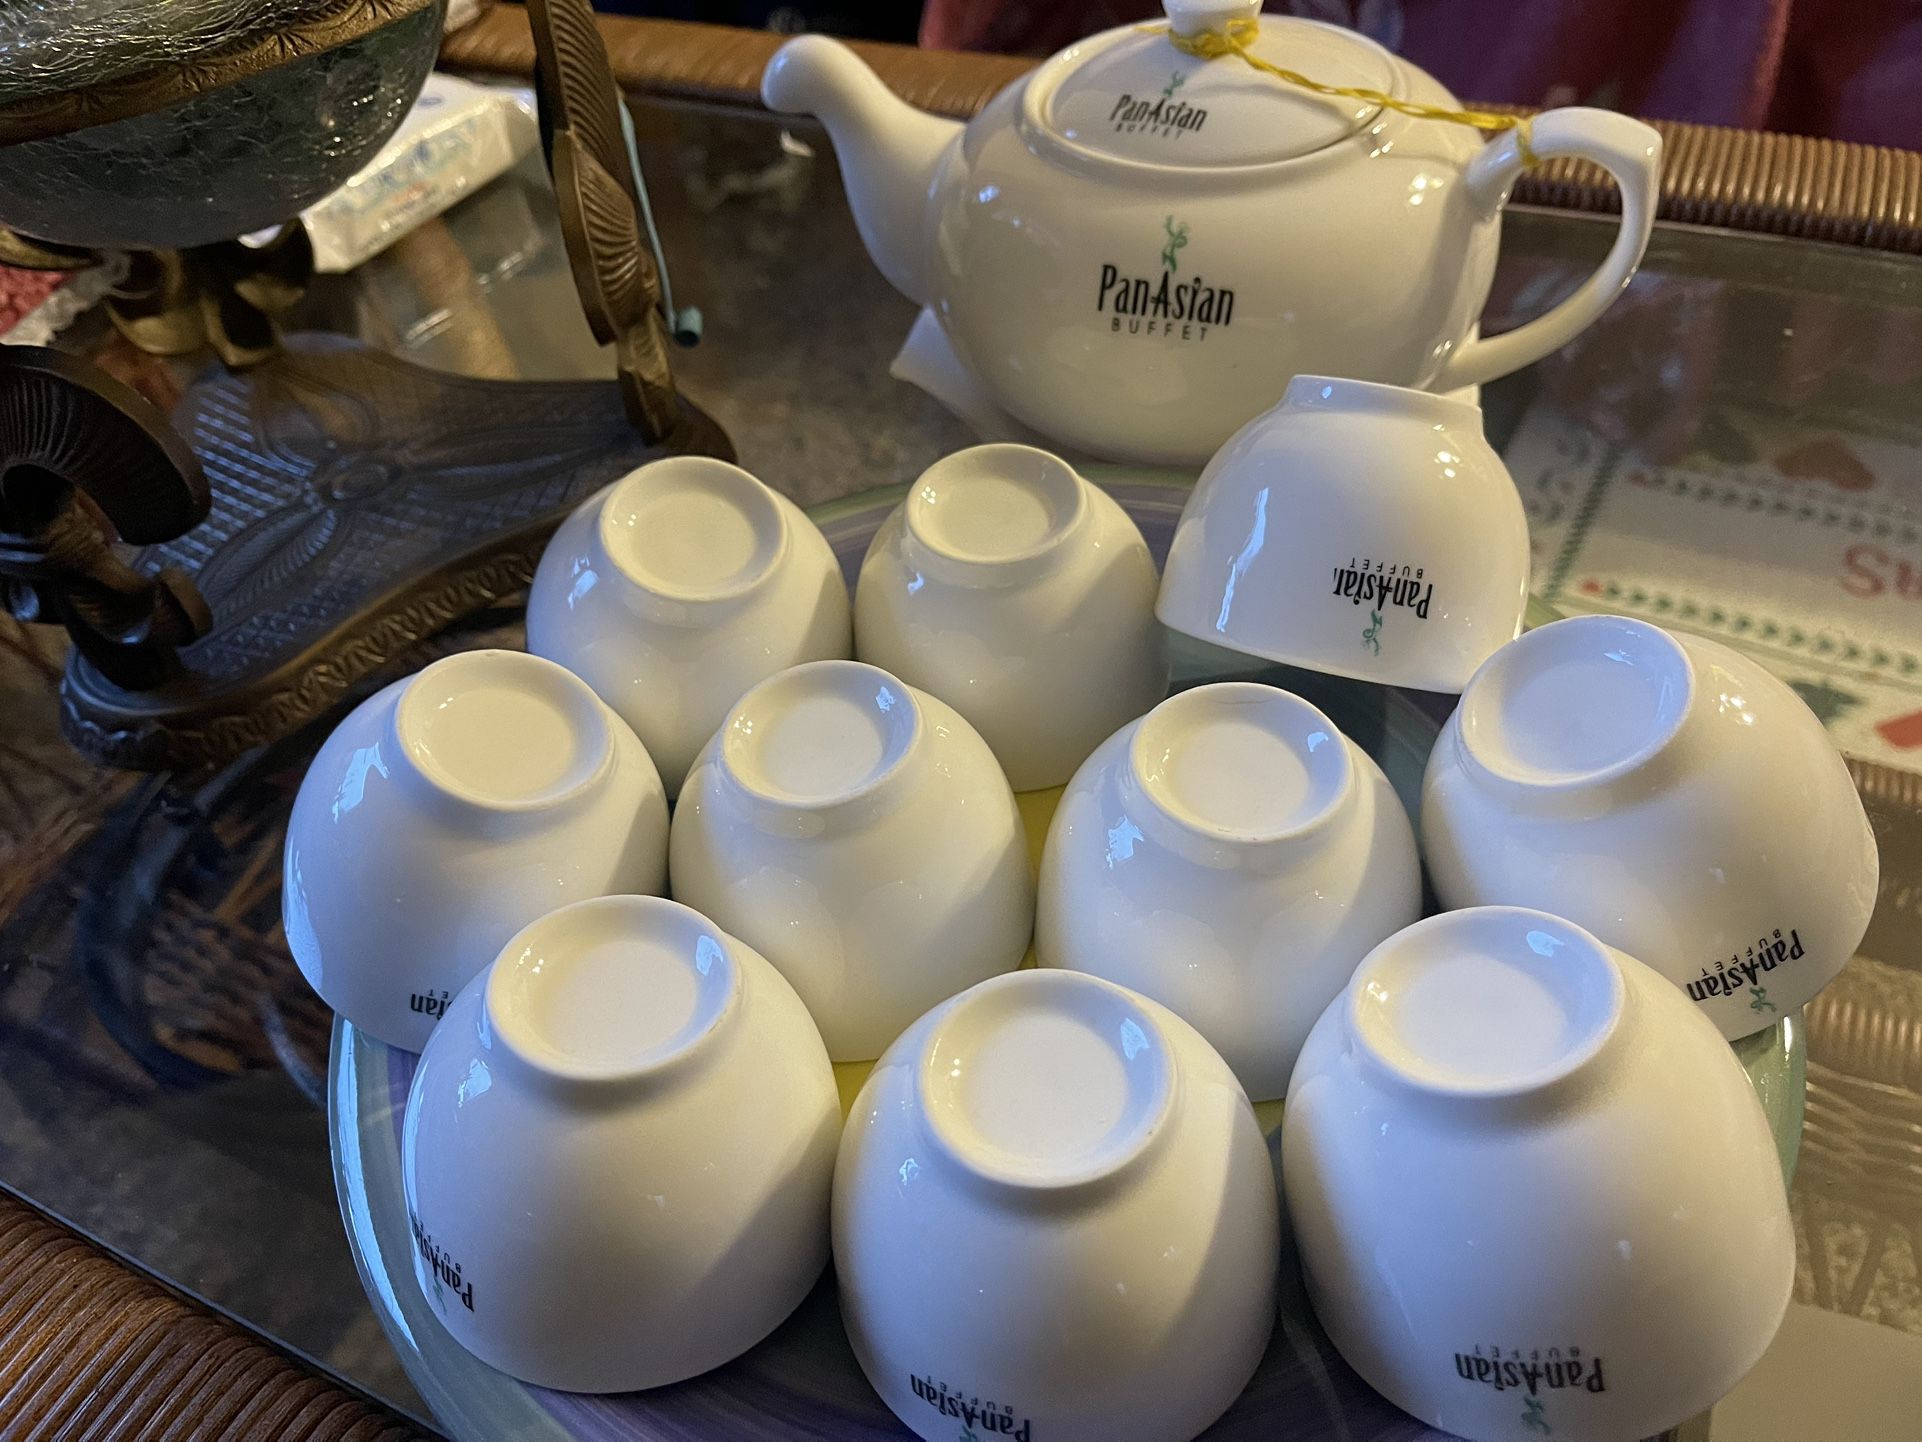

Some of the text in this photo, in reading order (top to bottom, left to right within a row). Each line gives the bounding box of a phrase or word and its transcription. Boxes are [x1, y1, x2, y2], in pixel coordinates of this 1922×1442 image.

[1110, 94, 1207, 131] PanAsian
[1098, 264, 1234, 326] PanAsian
[1111, 317, 1208, 341] BUFFET
[1350, 557, 1424, 579] BUFFET
[1686, 929, 1805, 1001] PanAsian
[1701, 929, 1781, 977] BUFFET
[1475, 1344, 1580, 1361] BUFFET
[1455, 1353, 1605, 1396] PanAsian
[910, 1374, 1030, 1442] PanAsian
[927, 1376, 1013, 1415] BUFFET
